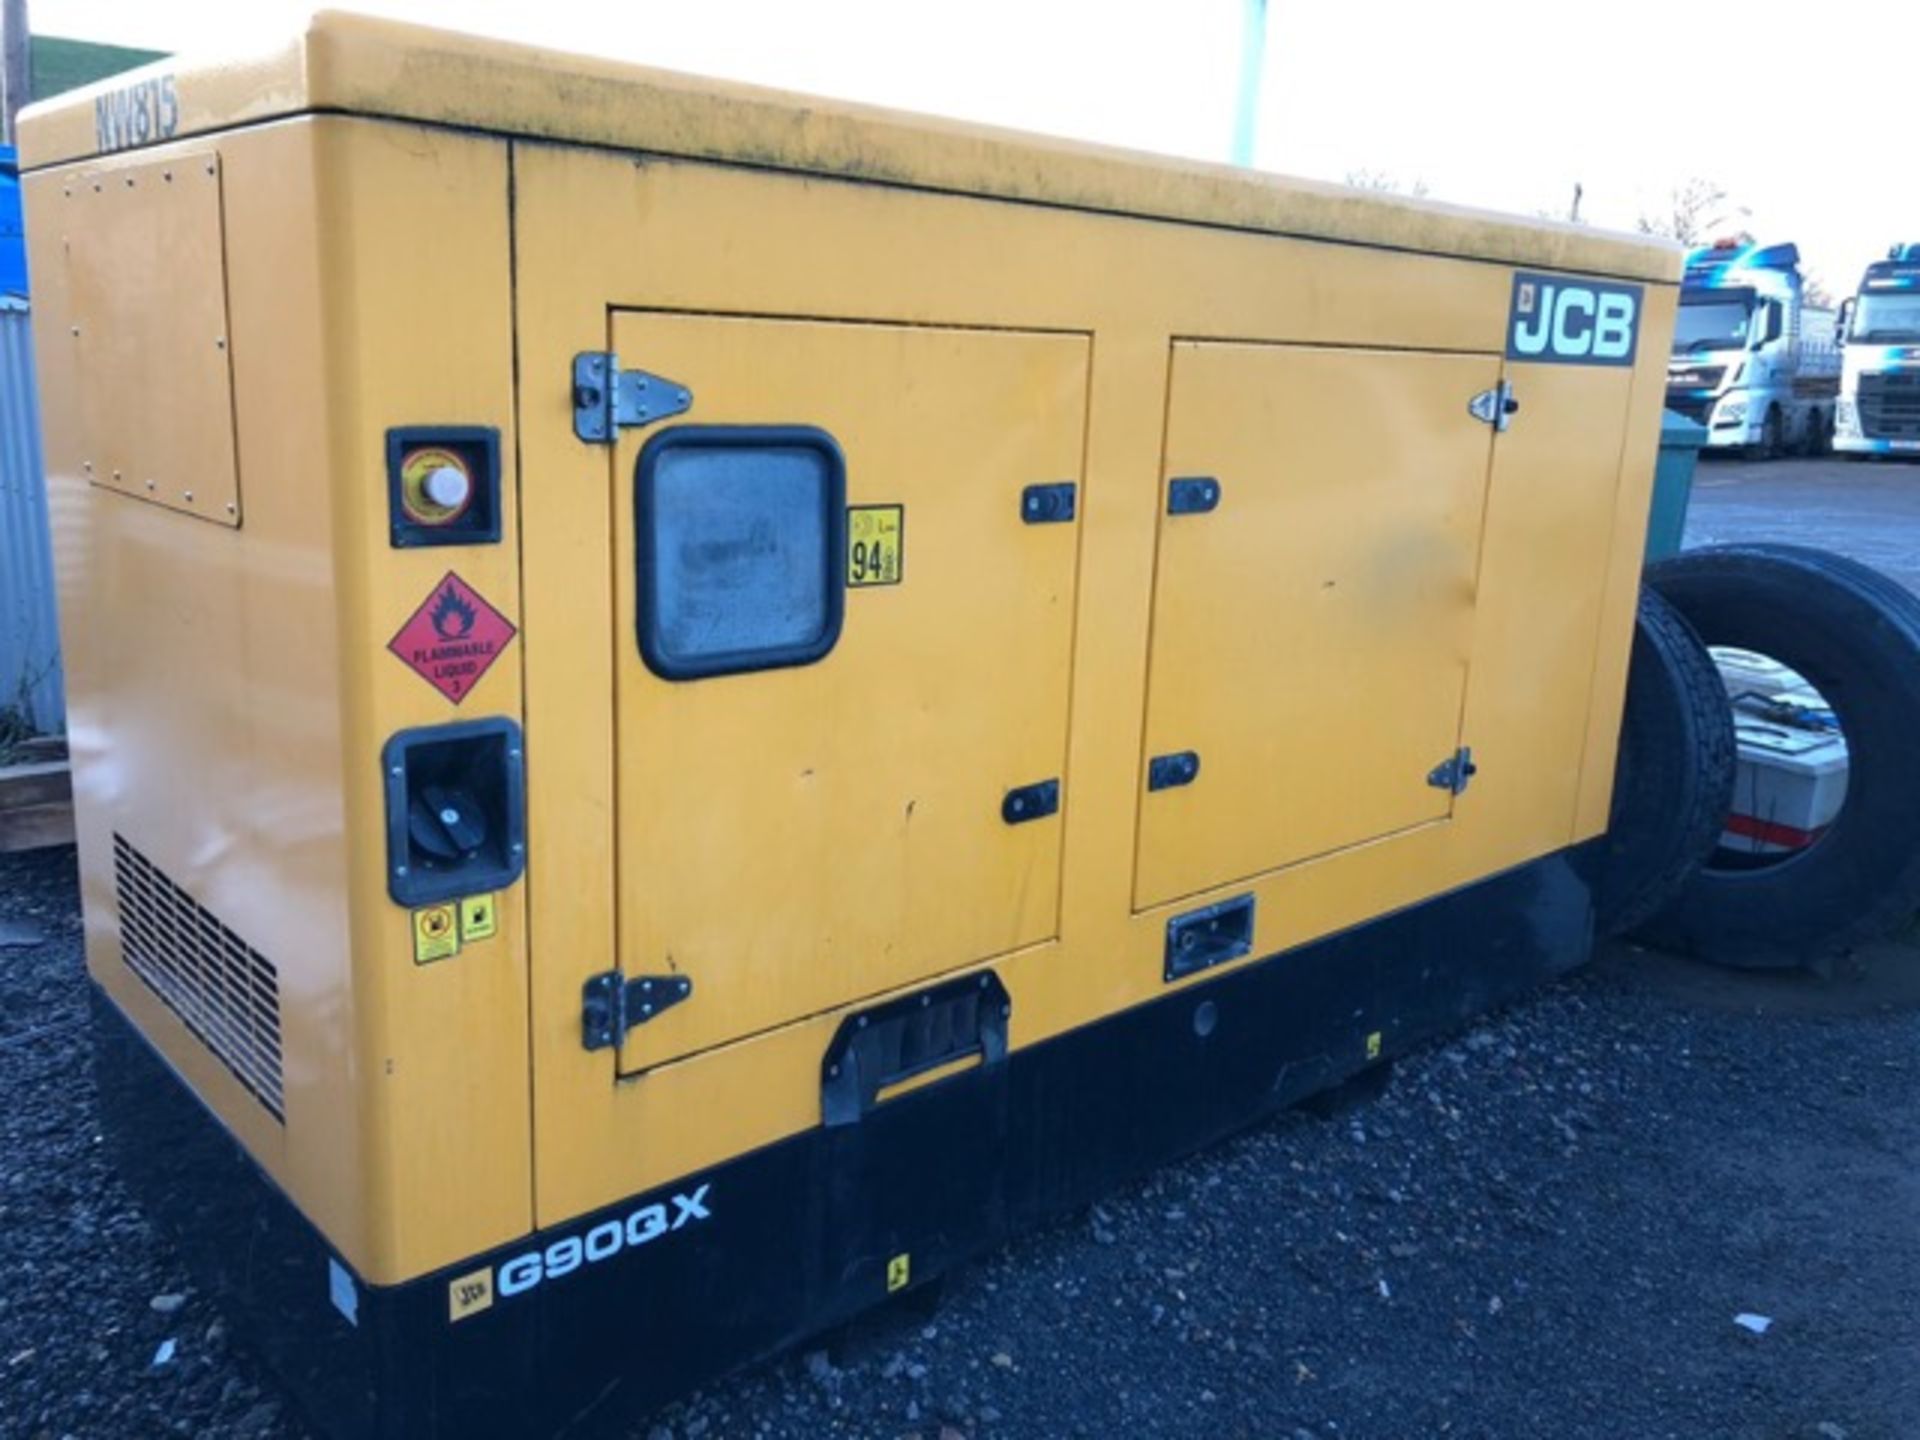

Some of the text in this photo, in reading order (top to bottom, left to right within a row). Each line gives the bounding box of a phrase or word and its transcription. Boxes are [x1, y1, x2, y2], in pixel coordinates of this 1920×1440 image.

[95, 74, 179, 154] NW815
[1513, 284, 1635, 358] JCB
[852, 539, 882, 581] 94
[413, 641, 493, 663] FLAMMABLE
[434, 661, 477, 679] LIQUID
[498, 1183, 711, 1297] G90QX
[460, 1282, 486, 1307] JCB
